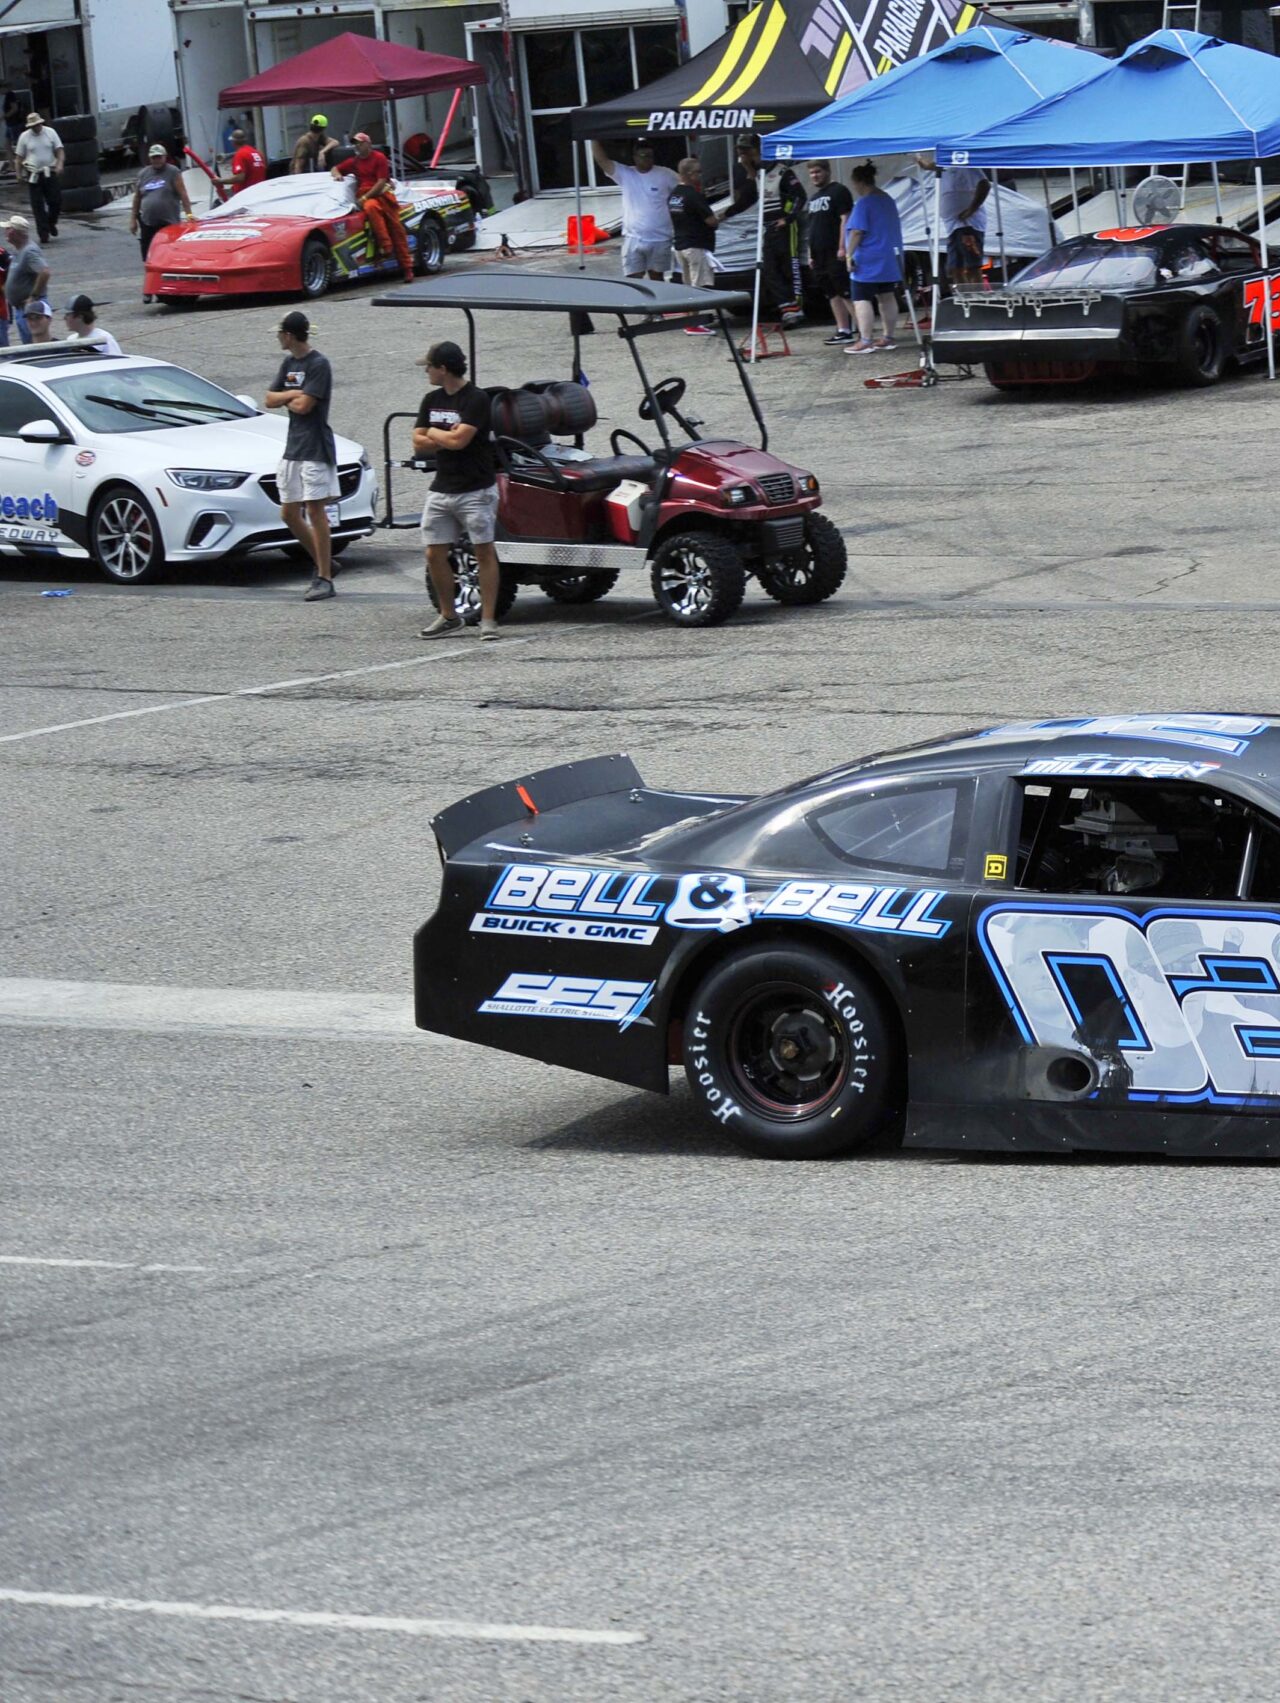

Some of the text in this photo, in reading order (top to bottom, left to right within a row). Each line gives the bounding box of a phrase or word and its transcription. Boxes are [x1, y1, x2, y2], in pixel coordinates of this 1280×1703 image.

[647, 109, 755, 131] PARAGON
[0, 493, 58, 521] each
[482, 917, 648, 940] BUICK GMC
[823, 982, 875, 1093] Hoosier
[689, 1011, 743, 1124] Hoosier
